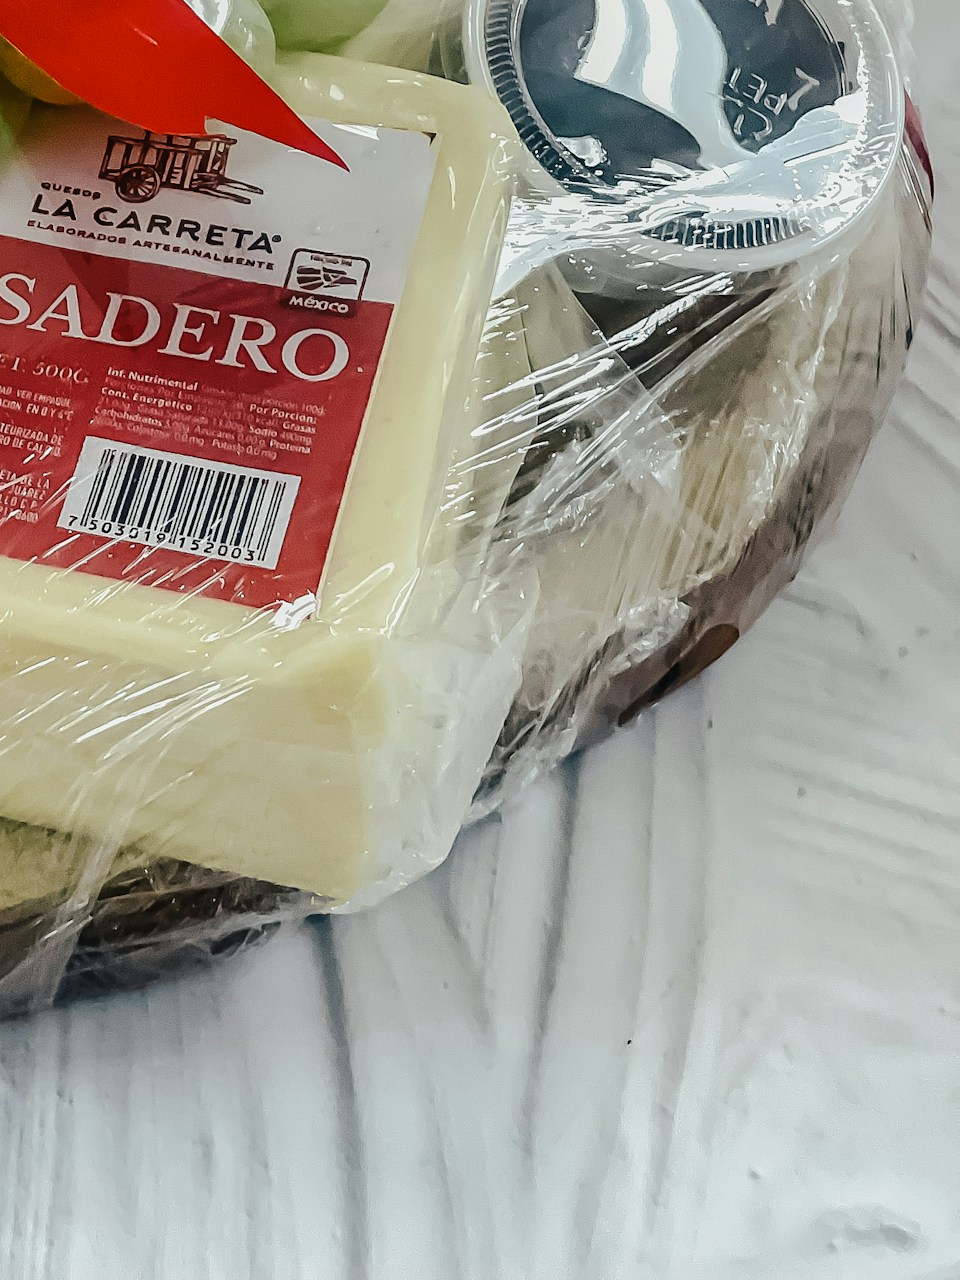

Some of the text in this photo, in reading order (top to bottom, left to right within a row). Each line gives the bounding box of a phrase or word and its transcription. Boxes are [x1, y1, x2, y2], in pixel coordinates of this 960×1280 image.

[31, 193, 278, 255] LA CARRETA
[27, 219, 126, 243] ELABORADOS
[132, 238, 275, 270] ARTESANALMENTE
[289, 293, 349, 315] México
[107, 366, 126, 377] Inf.
[128, 371, 198, 390] Nutrimental
[16, 389, 32, 399] VER
[26, 403, 39, 414] EN
[49, 408, 56, 418] Y
[249, 404, 268, 414] Por
[12, 437, 24, 448] DE
[50, 434, 63, 444] DE
[36, 478, 50, 489] LA
